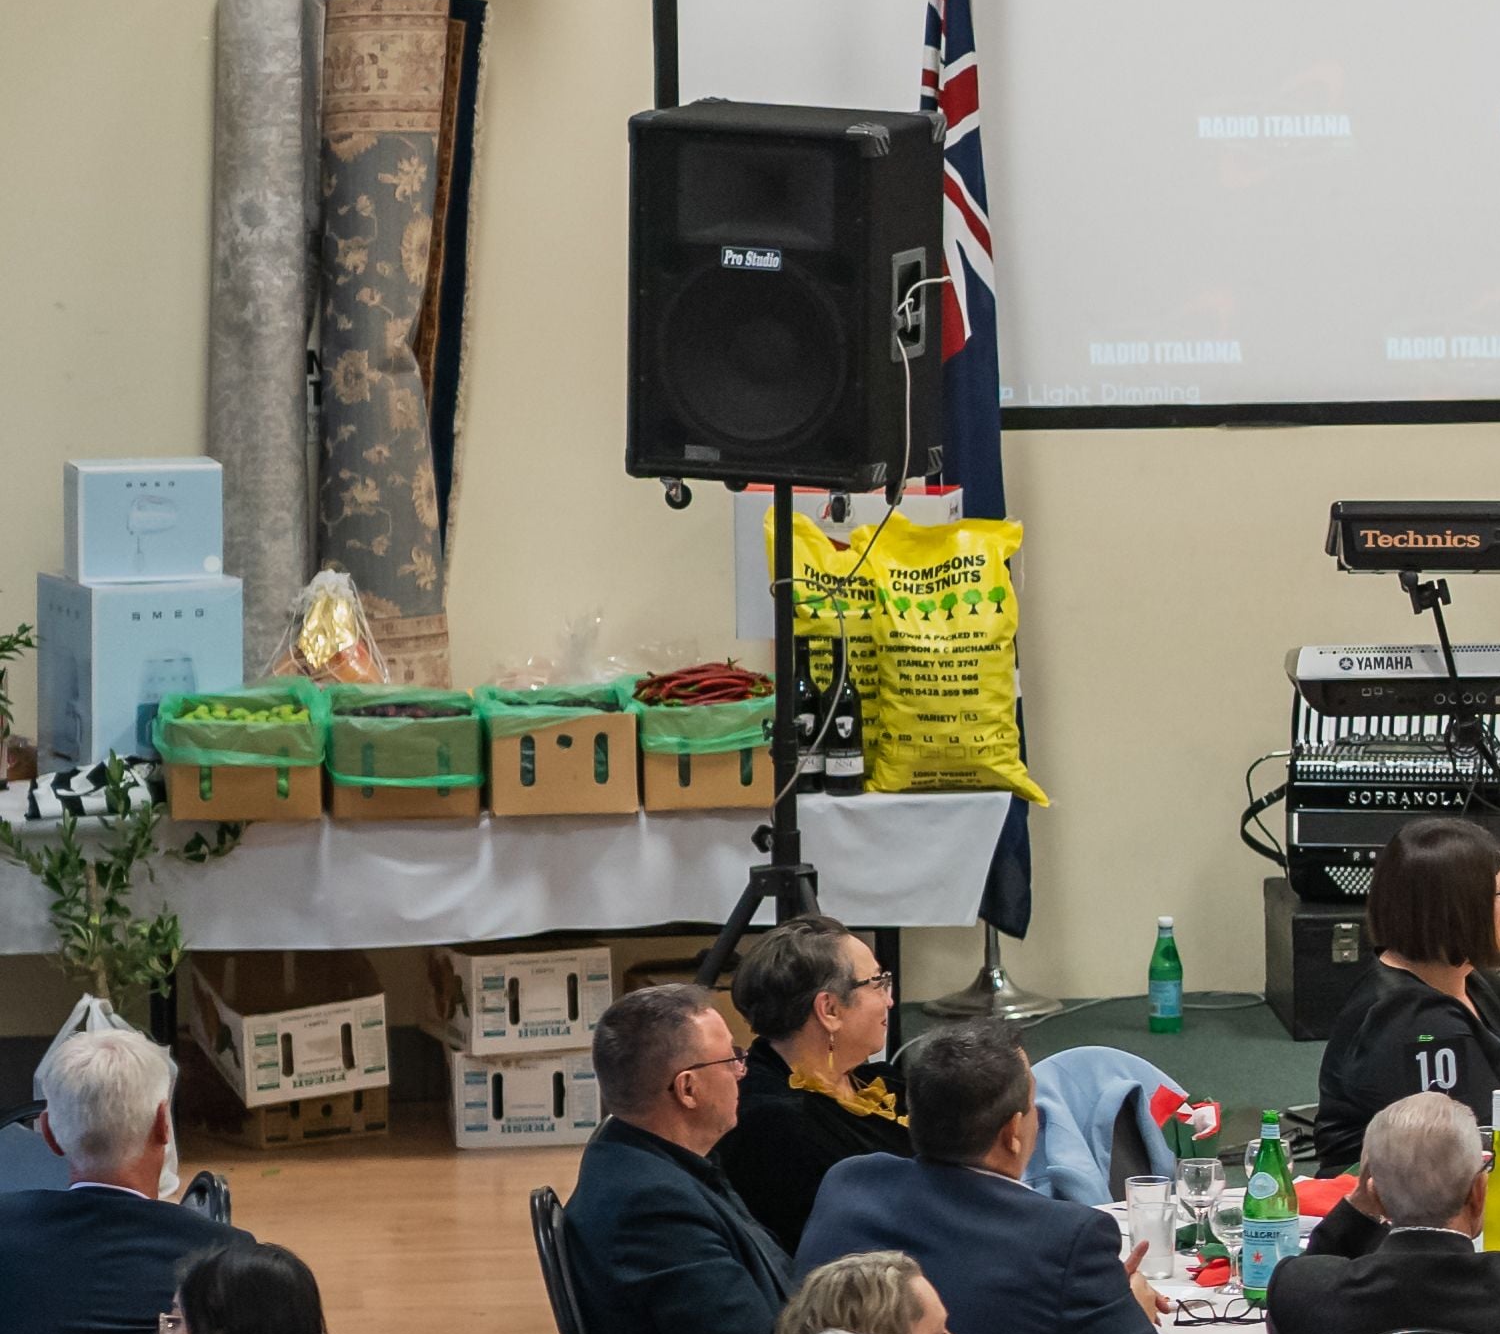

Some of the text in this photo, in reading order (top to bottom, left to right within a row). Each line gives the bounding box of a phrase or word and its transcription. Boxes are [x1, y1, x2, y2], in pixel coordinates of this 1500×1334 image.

[724, 249, 779, 267] Pro Studio
[1360, 529, 1481, 549] Technics
[888, 554, 986, 581] THOMPSONS
[892, 570, 981, 595] CHESTNUTS
[1356, 655, 1413, 671] YAMAHA
[1348, 791, 1464, 806] SOPRANOLA
[1415, 1047, 1457, 1093] 10
